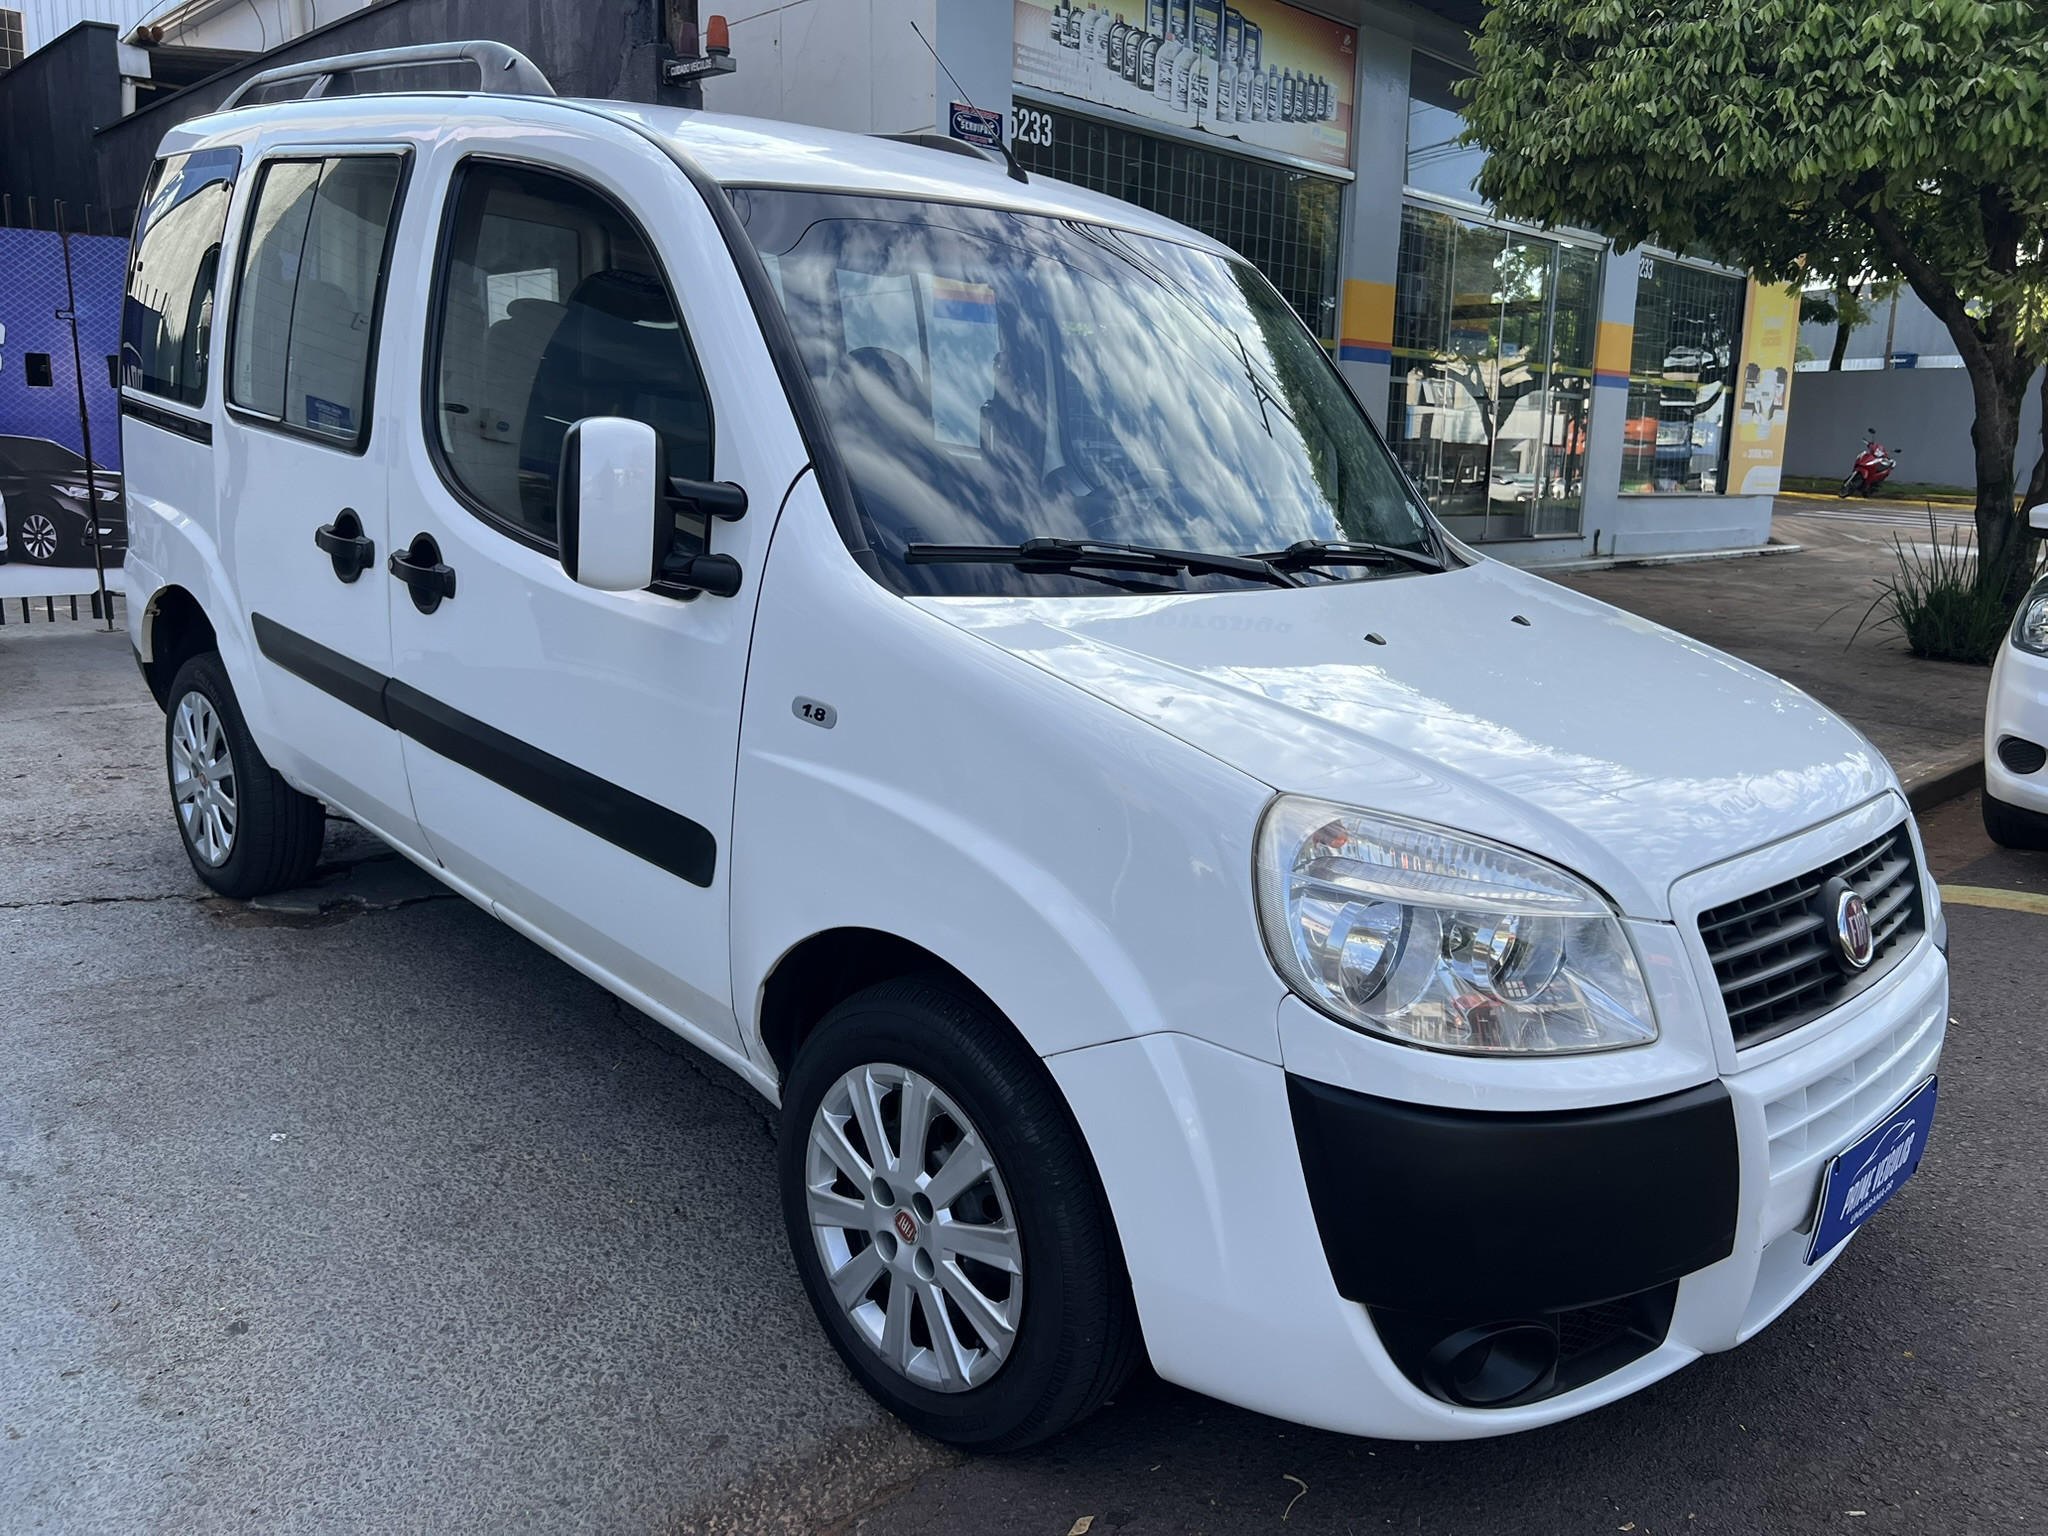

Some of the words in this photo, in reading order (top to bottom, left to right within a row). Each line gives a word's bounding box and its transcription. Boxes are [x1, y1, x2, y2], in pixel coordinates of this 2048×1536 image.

[670, 64, 690, 76] CUIDADO
[802, 703, 826, 722] 1.8
[1840, 1166, 1877, 1220] PRIME
[897, 1215, 915, 1238] FIAT
